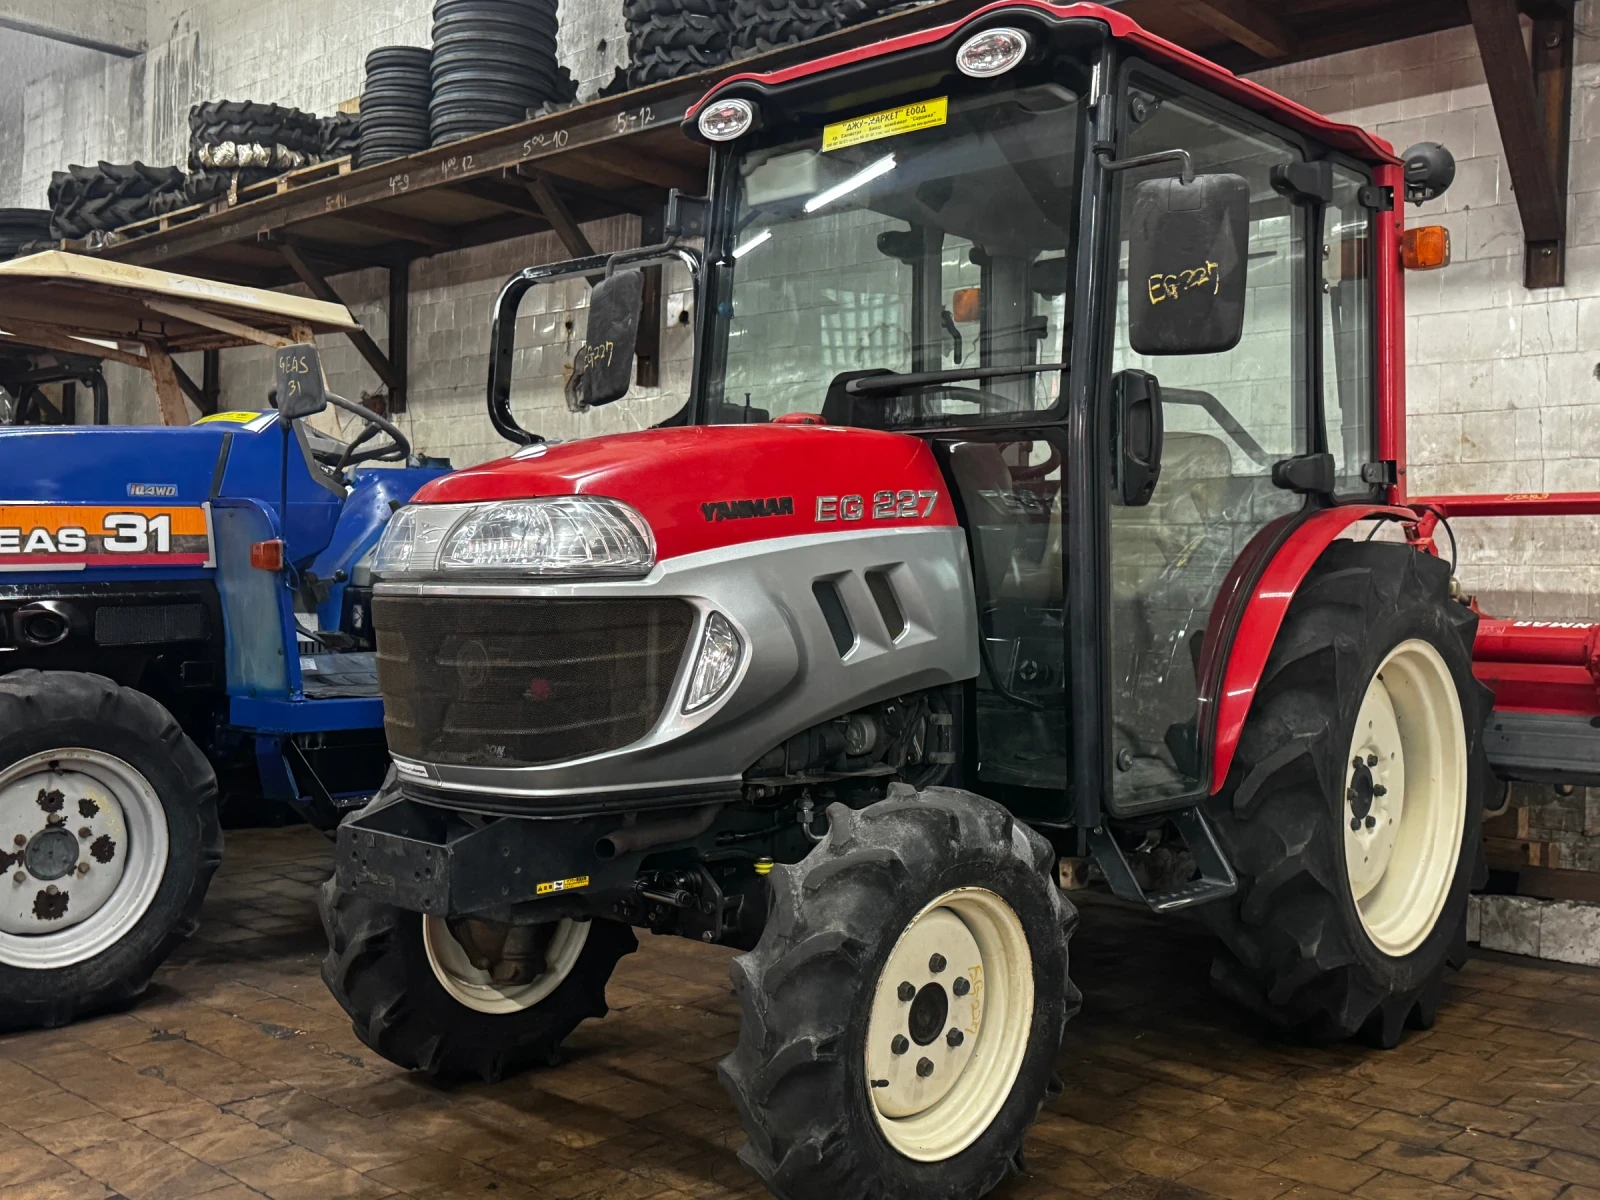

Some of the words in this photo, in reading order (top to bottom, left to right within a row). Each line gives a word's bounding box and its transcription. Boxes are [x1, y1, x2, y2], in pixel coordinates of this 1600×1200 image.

[905, 104, 927, 117] ЕООД
[1148, 260, 1219, 305] EG227
[279, 355, 309, 374] GEAS
[288, 380, 302, 397] 31
[702, 496, 795, 522] YANMAR
[815, 494, 864, 522] EG
[872, 489, 939, 519] 227
[103, 513, 171, 553] 31
